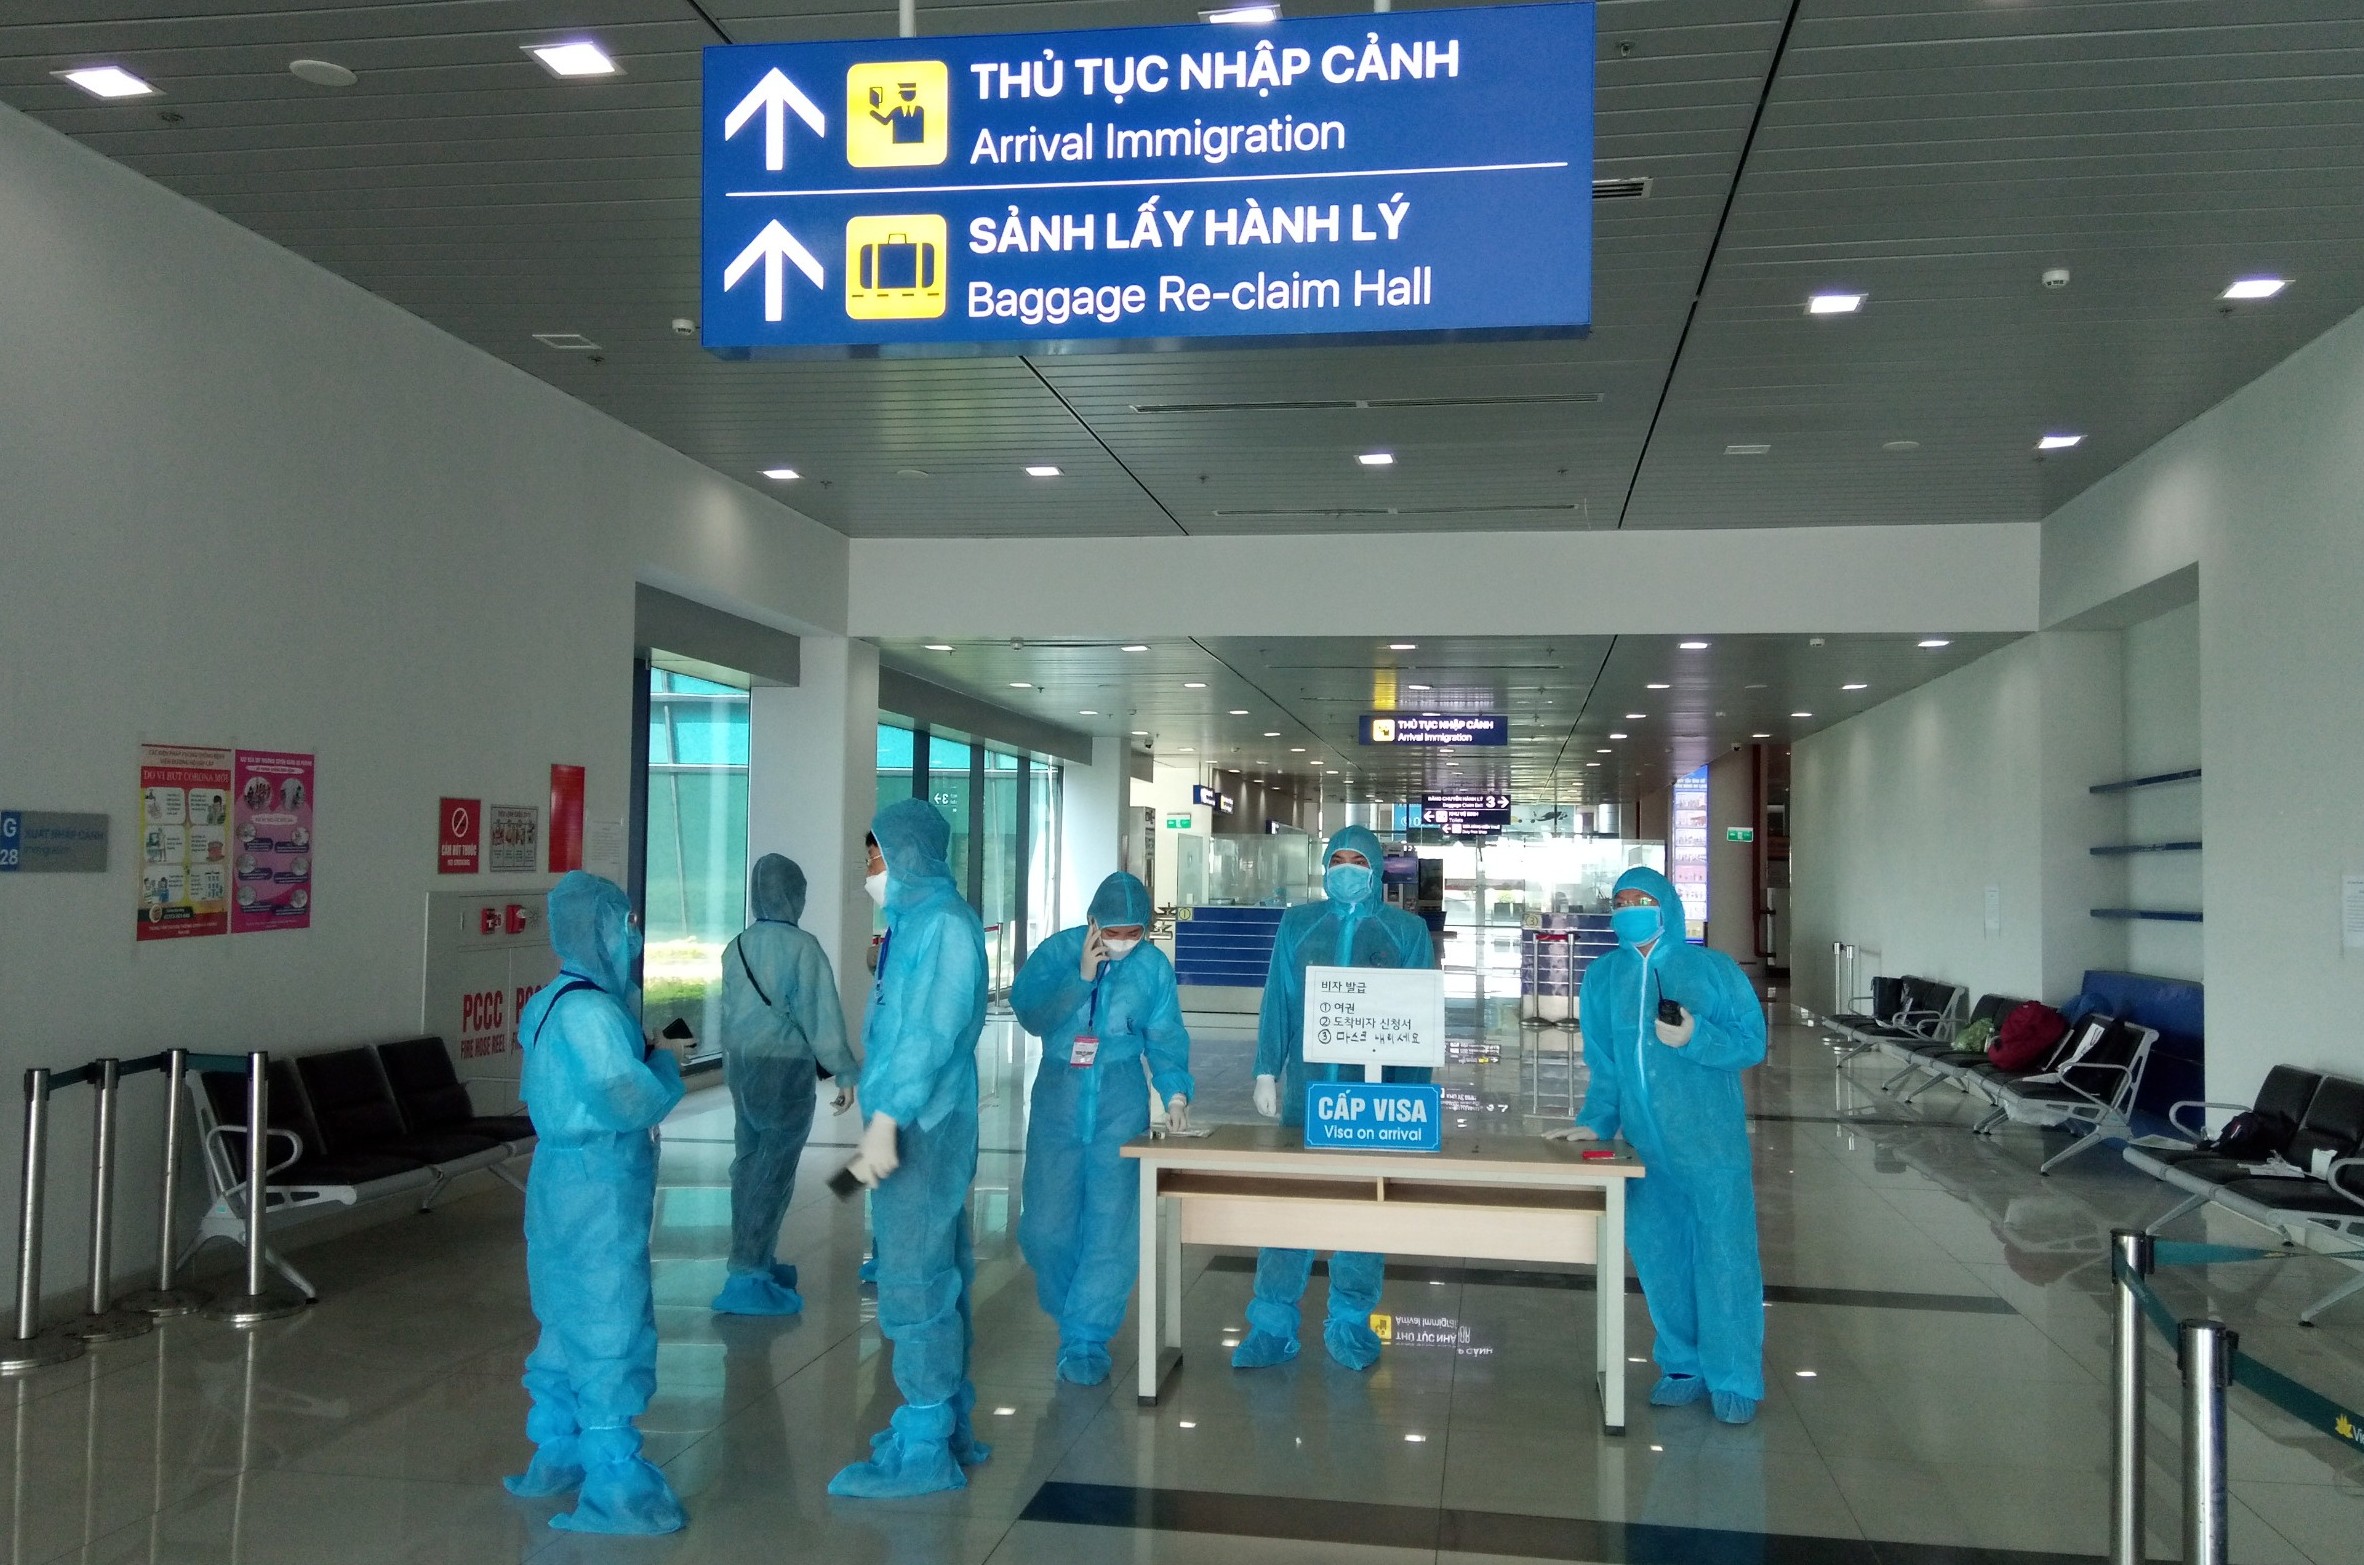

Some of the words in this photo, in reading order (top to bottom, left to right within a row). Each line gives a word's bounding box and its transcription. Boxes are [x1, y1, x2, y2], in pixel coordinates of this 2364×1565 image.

[970, 48, 1064, 100] THỦ
[1074, 54, 1169, 104] TỤC
[1180, 39, 1311, 97] NHẬP
[1321, 31, 1459, 84] CẢNH
[970, 122, 1093, 165] Arrival
[1106, 114, 1345, 164] Immigration
[968, 204, 1095, 254] SẢNH
[1106, 194, 1195, 249] LẤY
[1204, 197, 1340, 246] HÀNH
[1351, 192, 1411, 242] LÝ
[968, 280, 1146, 325] Baggage
[1159, 270, 1340, 313] Re-claim
[1354, 265, 1432, 307] Hall
[1397, 733, 1423, 742] Arrival
[1424, 732, 1473, 743] Immigration
[1485, 795, 1496, 809] 3
[3, 817, 17, 838] G
[0, 848, 18, 866] 28
[1321, 980, 1342, 992] 비자
[1345, 981, 1367, 993] 발급
[463, 990, 503, 1033] PCCC
[1334, 1002, 1355, 1014] 여권
[1333, 1016, 1376, 1028] 도착비자
[1379, 1018, 1412, 1030] 신청서
[460, 1038, 474, 1060] FIRE
[474, 1035, 490, 1057] HOSE
[491, 1033, 505, 1055] REEL
[1336, 1031, 1367, 1044] 마스크
[1318, 1089, 1366, 1121] CẤP
[1373, 1098, 1428, 1123] VISA
[1324, 1125, 1353, 1139] Visa
[1357, 1129, 1374, 1140] on
[1378, 1127, 1422, 1141] arrival
